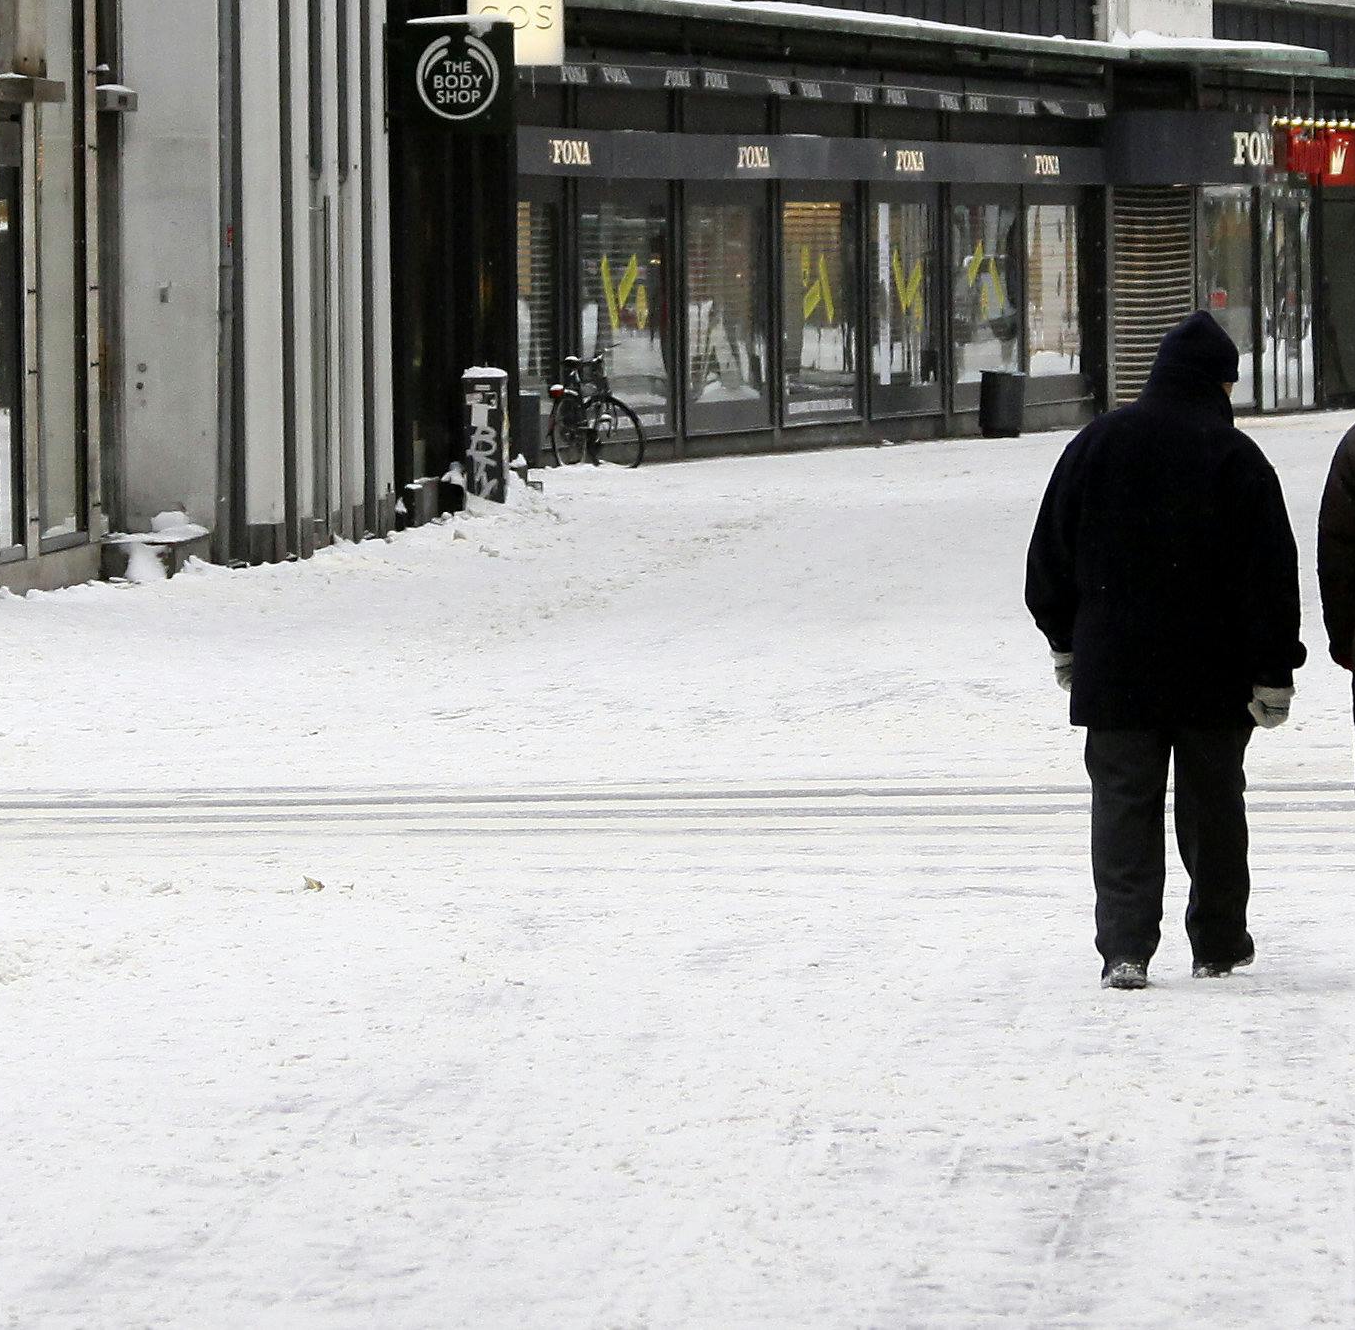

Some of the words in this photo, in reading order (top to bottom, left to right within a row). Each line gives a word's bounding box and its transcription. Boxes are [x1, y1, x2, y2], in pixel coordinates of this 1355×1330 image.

[443, 60, 472, 74] THE
[433, 74, 484, 89] BODY
[436, 90, 481, 104] SHOP
[552, 139, 591, 165] FONA
[737, 145, 771, 168] FONA
[1233, 131, 1275, 166] FON
[896, 149, 925, 172] FONA
[1034, 154, 1061, 176] FONA
